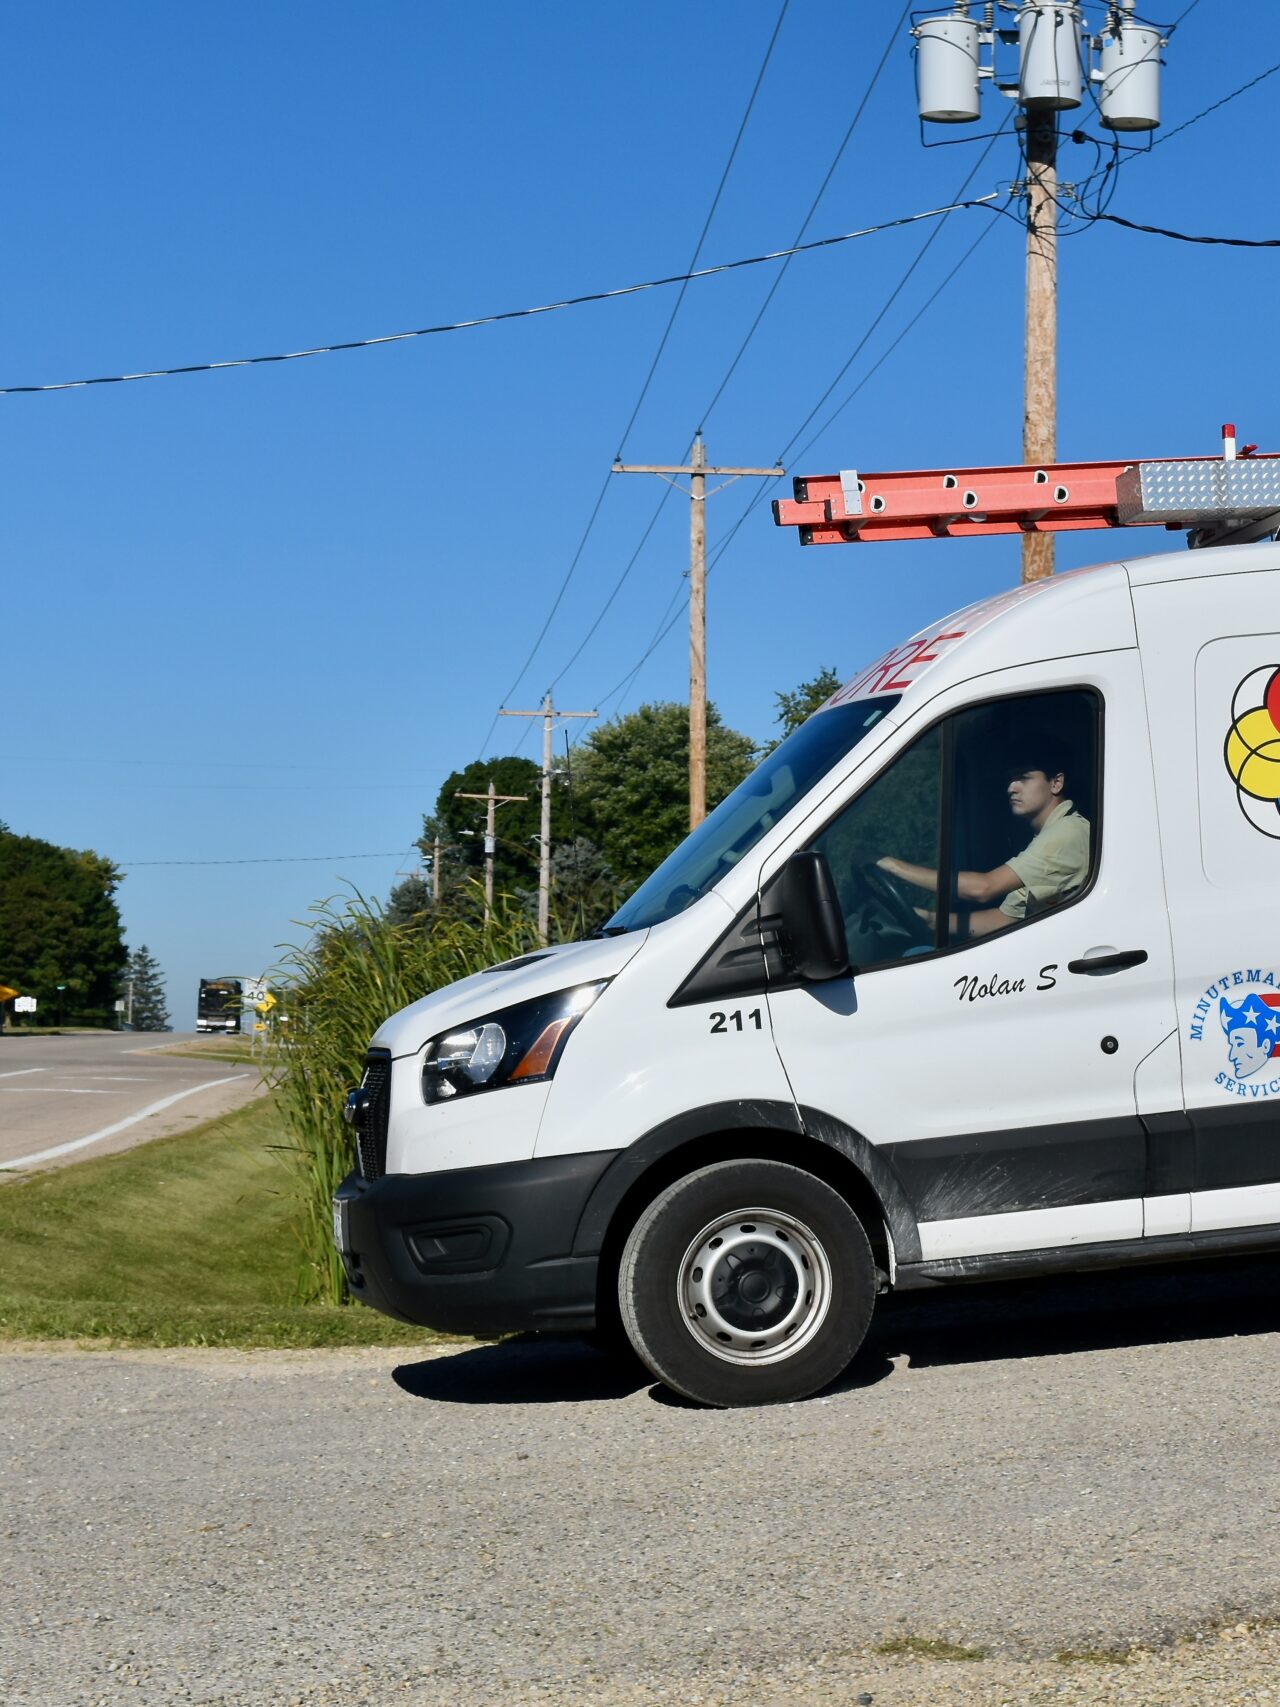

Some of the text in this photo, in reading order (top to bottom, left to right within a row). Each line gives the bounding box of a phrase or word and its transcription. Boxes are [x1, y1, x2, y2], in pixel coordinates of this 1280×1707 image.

[953, 964, 1058, 1002] Nolan S
[247, 991, 265, 1001] 40
[709, 1009, 763, 1034] 211
